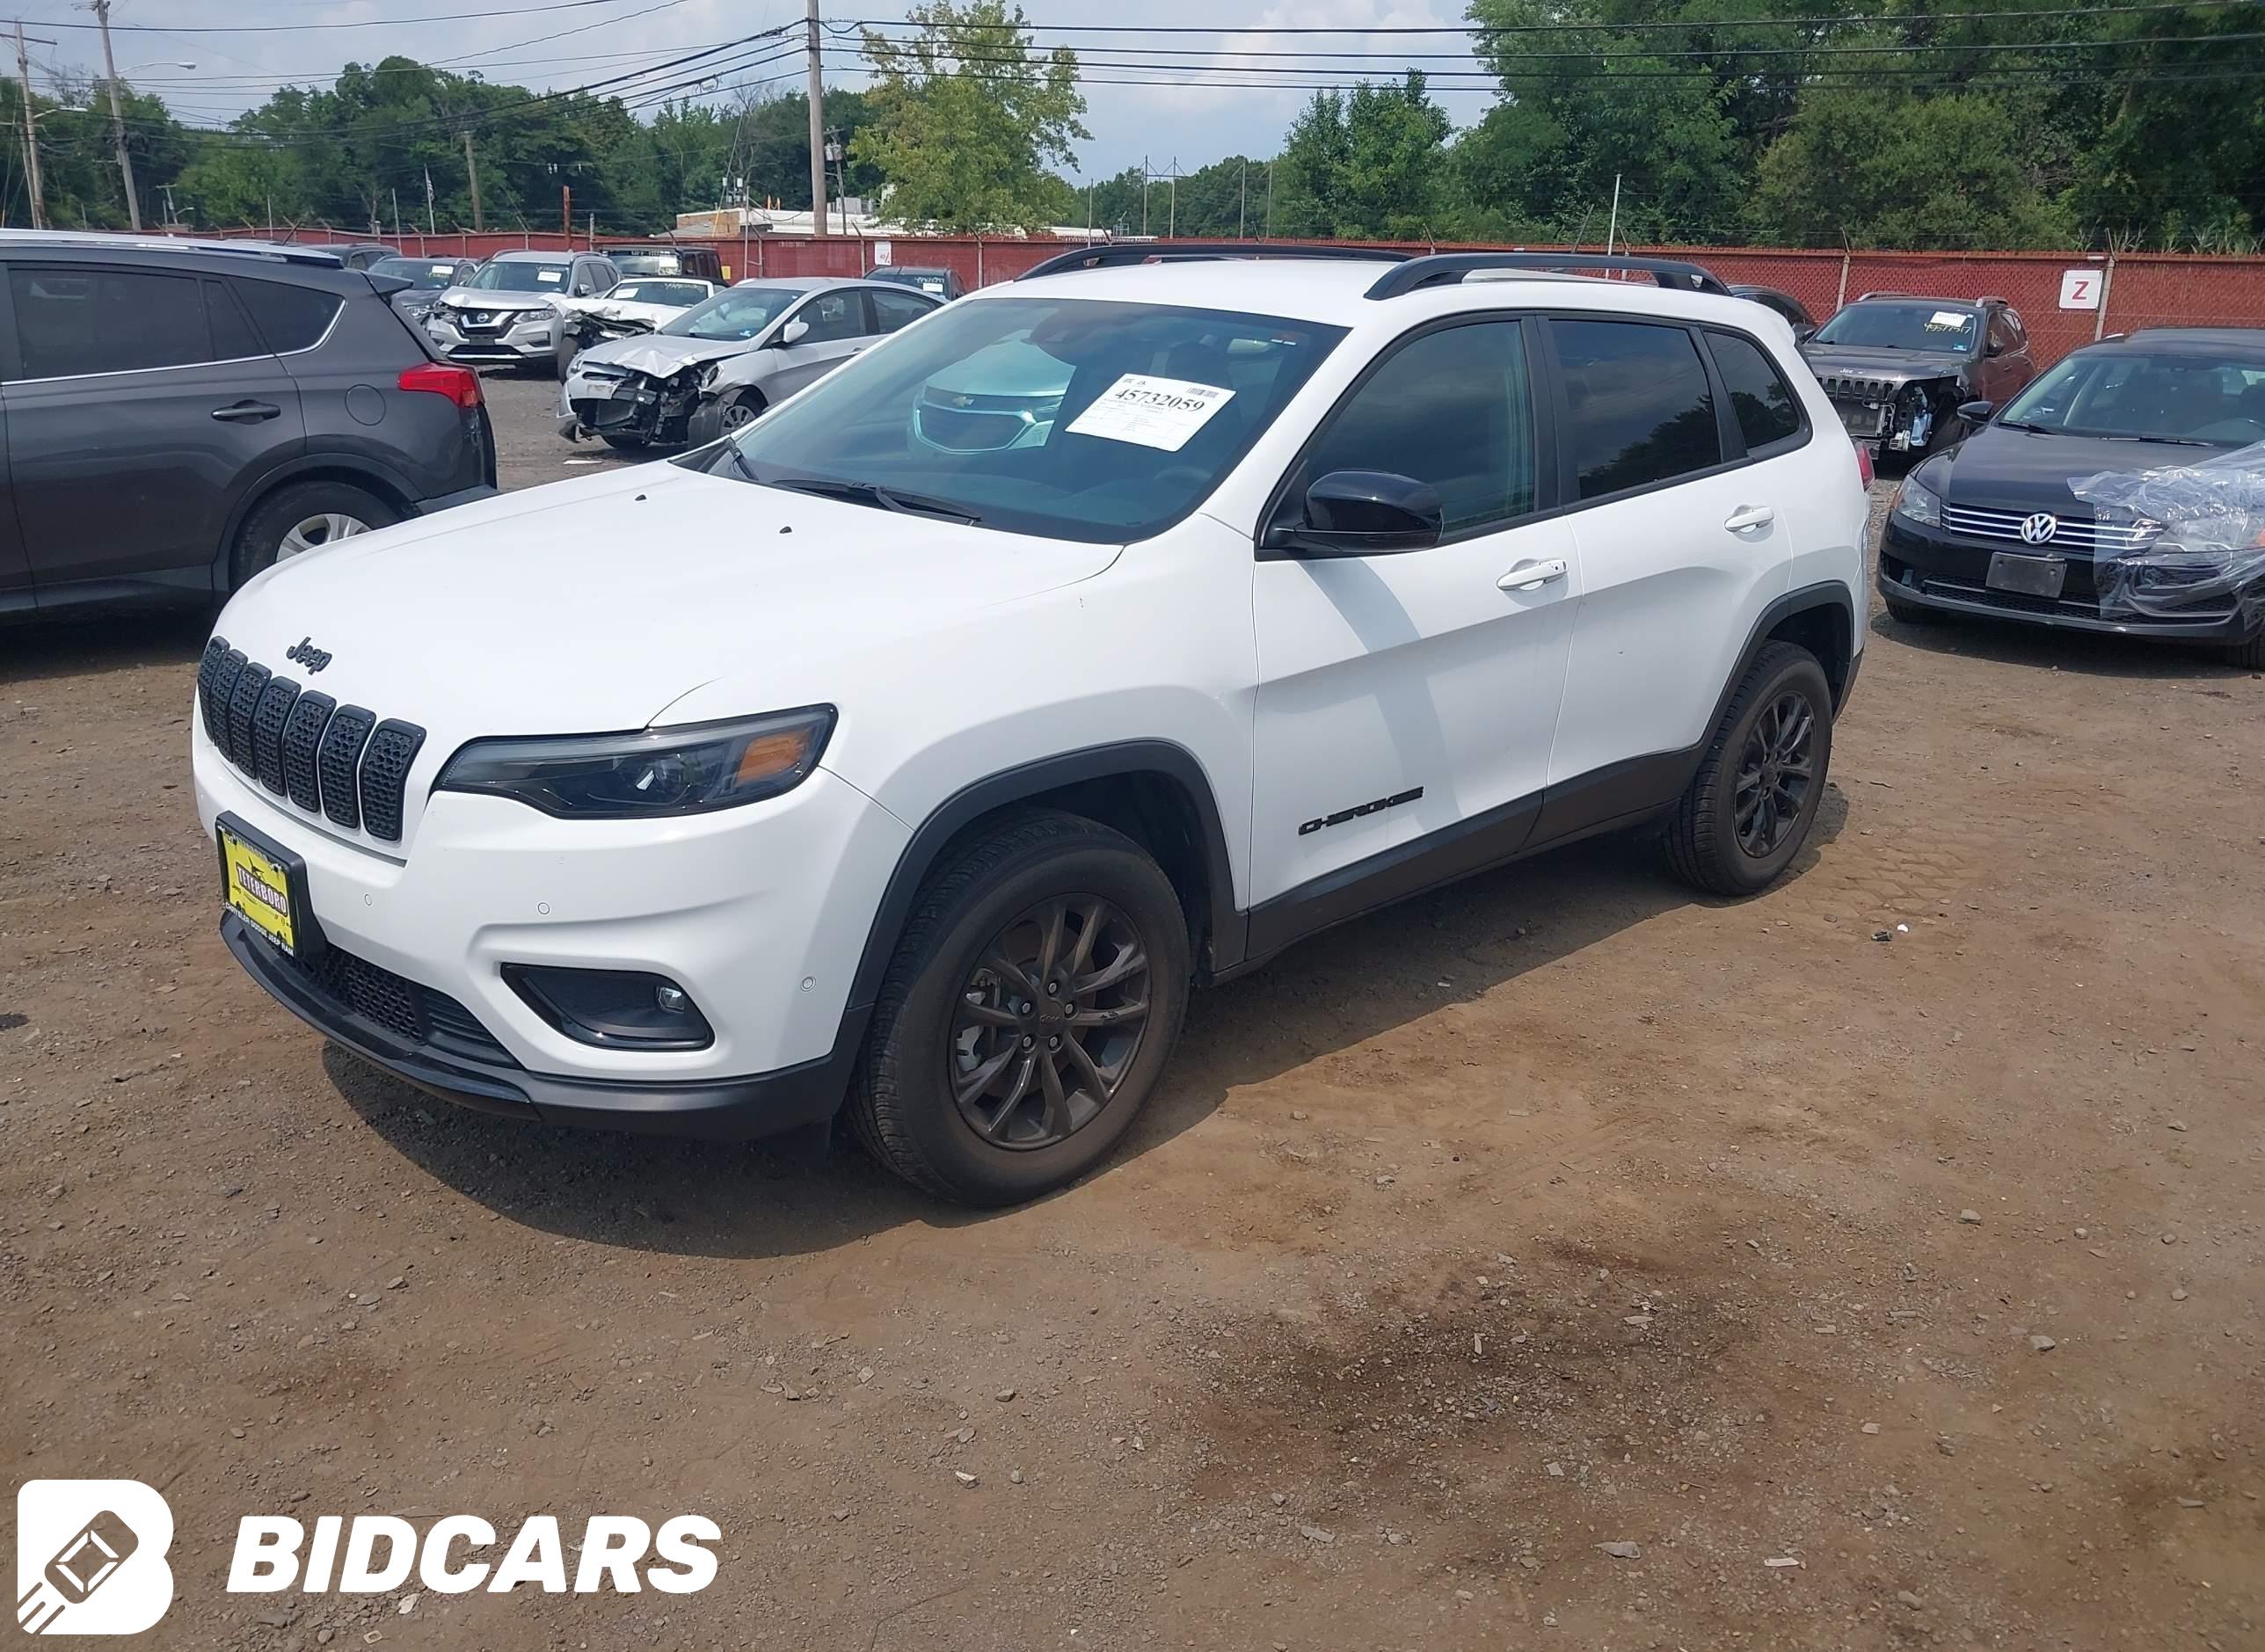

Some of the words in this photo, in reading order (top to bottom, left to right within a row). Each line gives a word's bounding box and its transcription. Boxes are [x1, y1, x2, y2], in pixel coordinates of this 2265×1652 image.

[2072, 280, 2089, 300] Z
[1115, 389, 1205, 412] 45732059
[286, 636, 332, 675] Jeep
[237, 866, 287, 913] TETERBORO
